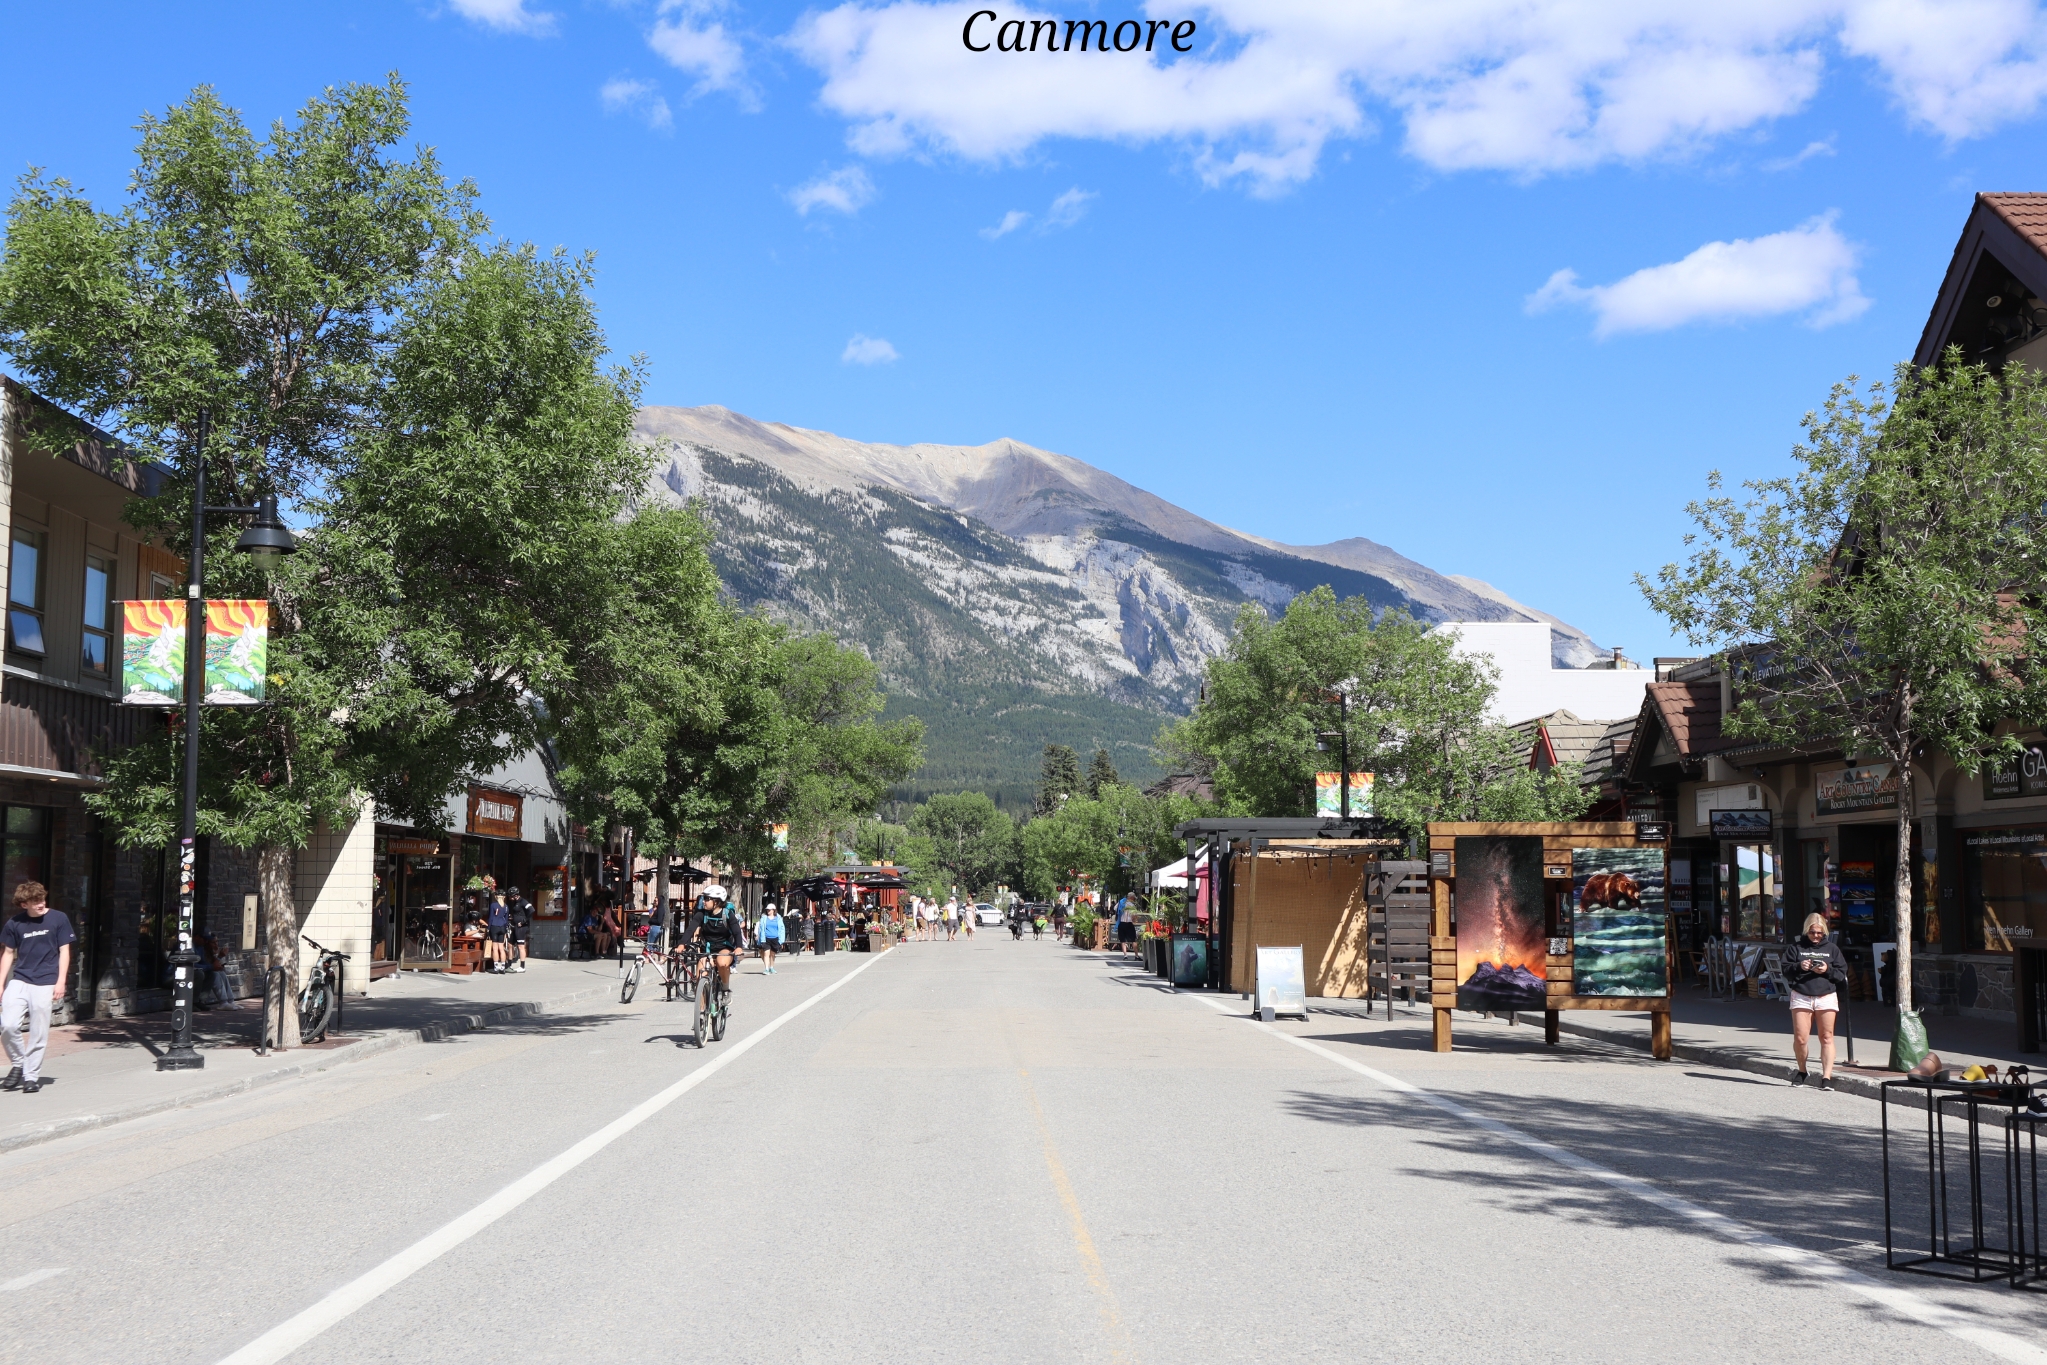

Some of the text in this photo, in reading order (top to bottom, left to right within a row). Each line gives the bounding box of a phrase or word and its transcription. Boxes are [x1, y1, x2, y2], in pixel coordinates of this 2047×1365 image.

[1752, 665, 1785, 682] ELEVATION
[1992, 769, 2018, 784] Hoehn
[1820, 775, 1900, 798] ART COUNTRY CANA
[1830, 793, 1896, 810] ROCKY MOUNTAIN GALLERY
[389, 842, 417, 850] VALHALLA
[2014, 925, 2034, 939] Gallery
